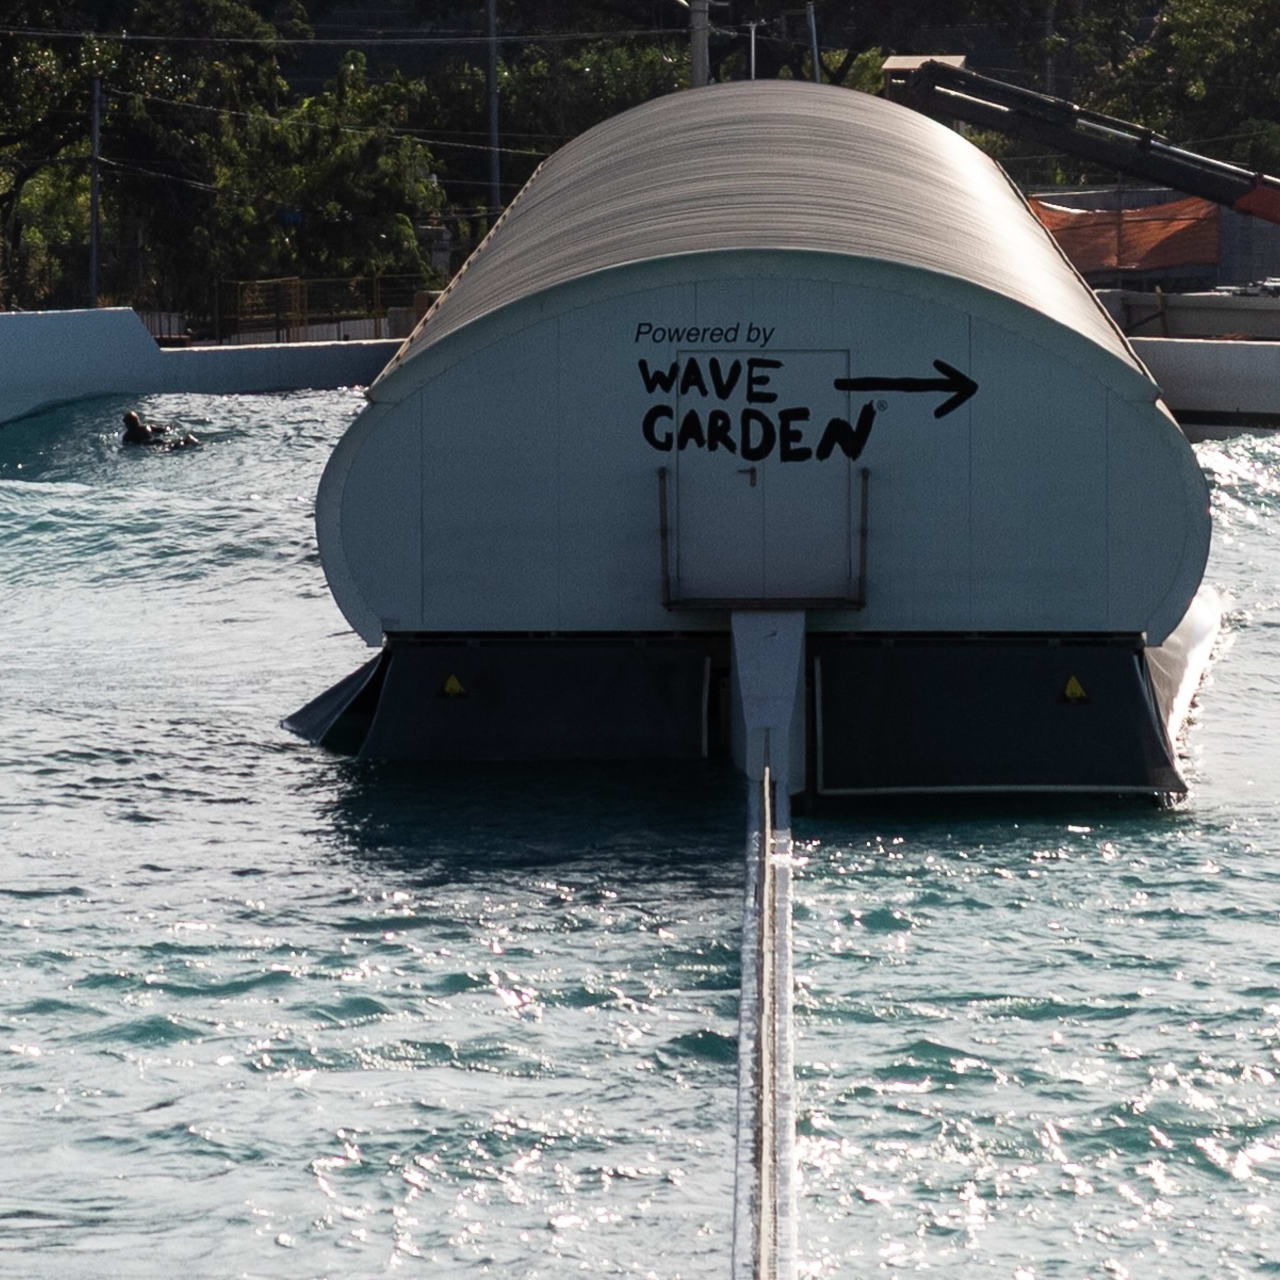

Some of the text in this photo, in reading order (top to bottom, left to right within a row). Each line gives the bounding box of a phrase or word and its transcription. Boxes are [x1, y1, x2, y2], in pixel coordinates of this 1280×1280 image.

[634, 322, 776, 349] Powered by
[638, 357, 784, 404] WAVE
